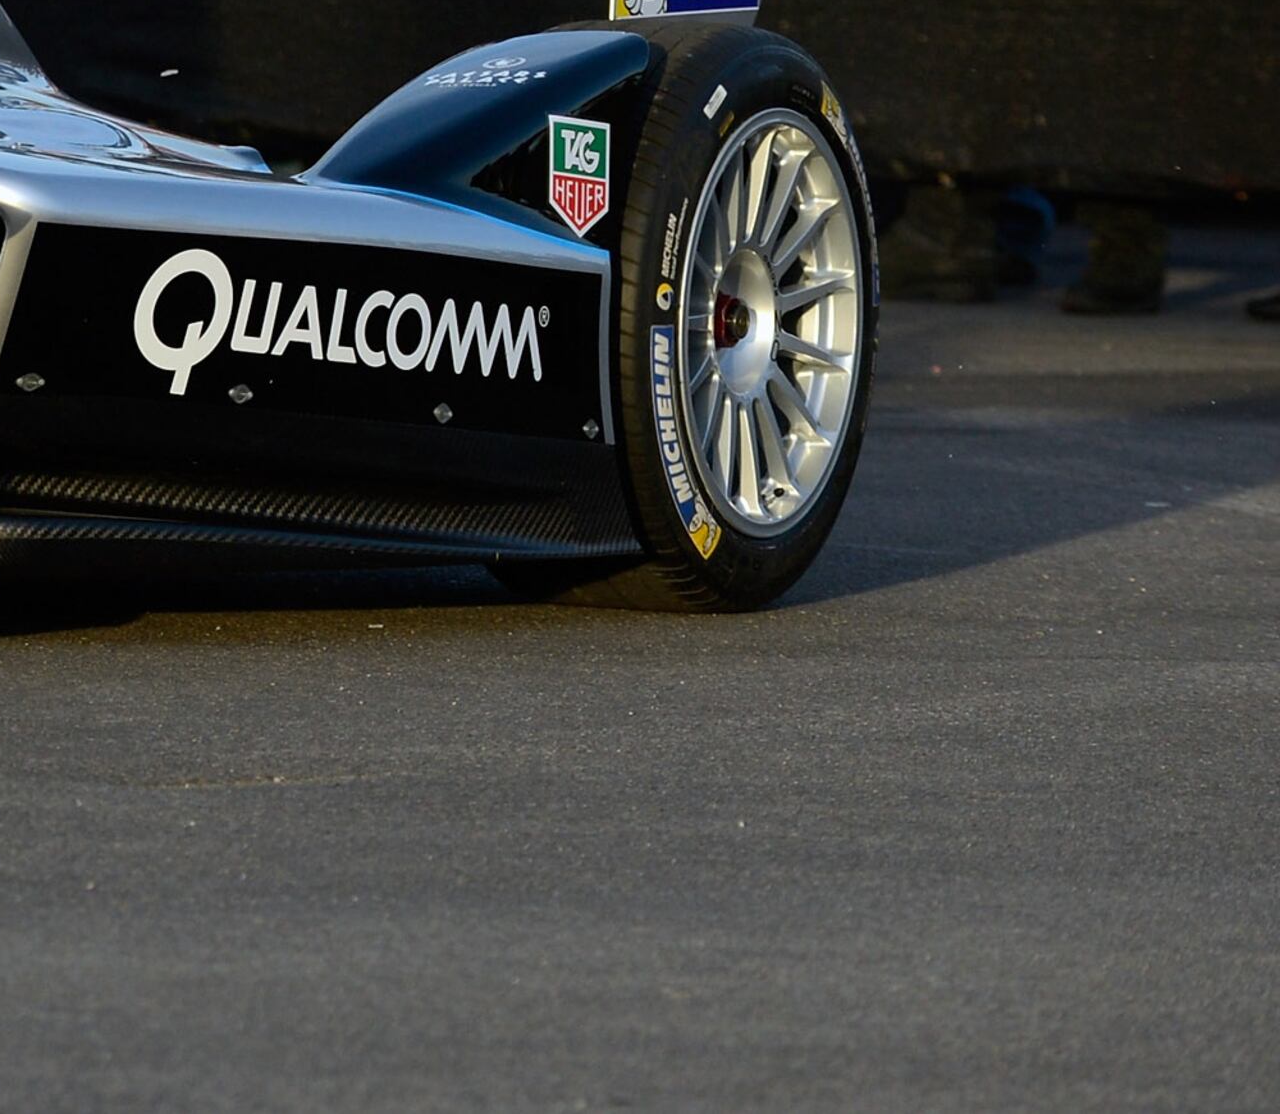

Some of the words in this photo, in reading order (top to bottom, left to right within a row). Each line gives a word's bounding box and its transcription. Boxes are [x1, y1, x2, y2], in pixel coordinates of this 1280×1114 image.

[560, 128, 600, 174] TAG
[554, 178, 605, 227] HEUER
[660, 212, 678, 278] MICHELIN
[654, 332, 694, 505] MICHELIN
